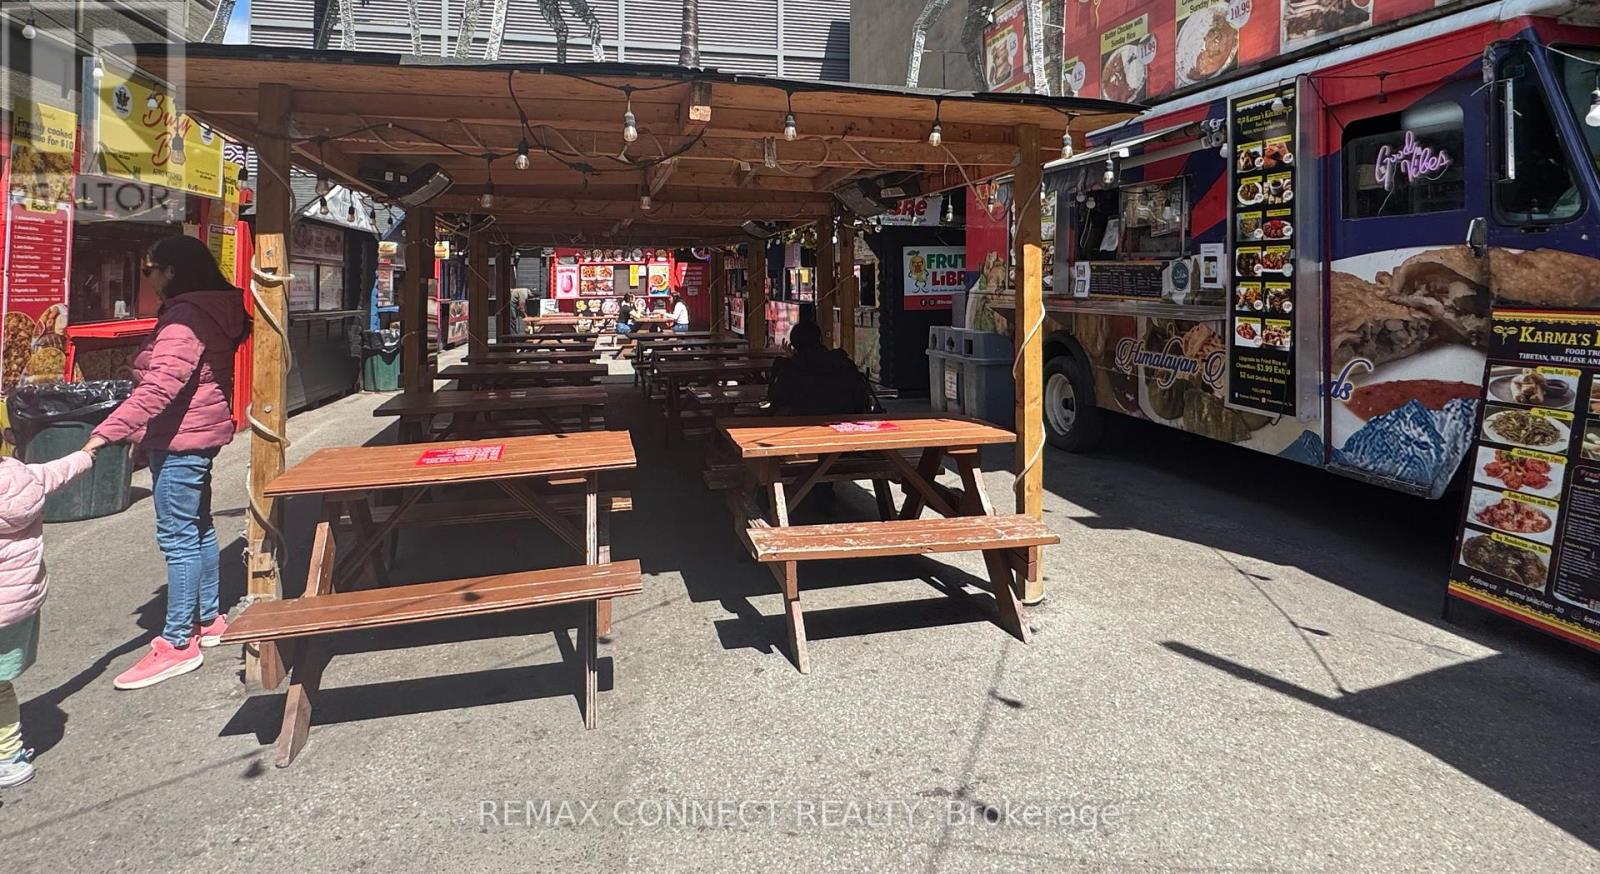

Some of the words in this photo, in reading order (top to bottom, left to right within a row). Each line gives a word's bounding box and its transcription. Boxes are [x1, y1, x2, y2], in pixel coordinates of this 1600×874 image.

[1231, 1, 1250, 20] 10.99
[47, 127, 73, 140] cooked
[47, 135, 59, 145] for
[60, 139, 74, 150] $10
[1375, 130, 1415, 186] Good
[1401, 145, 1450, 182] Vibes
[1519, 326, 1592, 346] KARMA'S
[1115, 336, 1199, 389] Himalayan
[1519, 352, 1549, 362] TIBETAN,
[1550, 355, 1587, 364] NEPALESE
[1273, 365, 1291, 375] Extra
